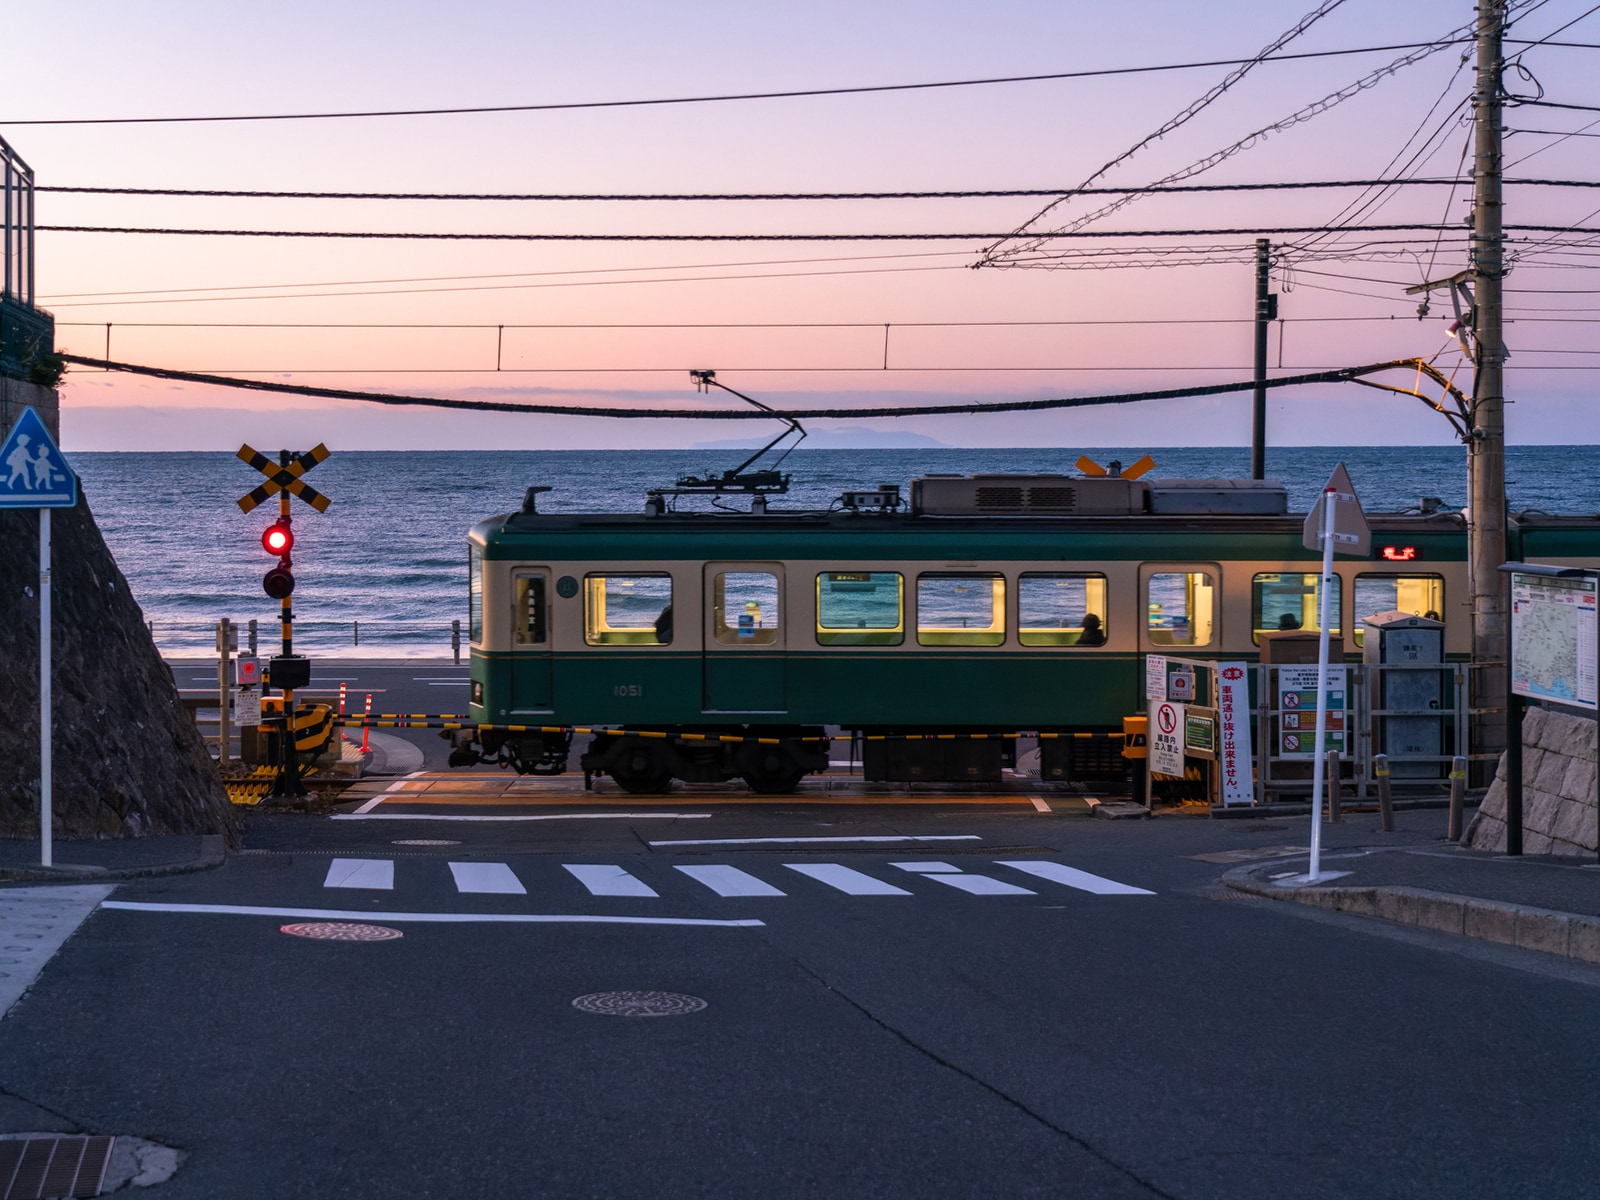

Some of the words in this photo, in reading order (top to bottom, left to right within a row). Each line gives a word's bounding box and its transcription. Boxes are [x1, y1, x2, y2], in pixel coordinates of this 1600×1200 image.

[613, 685, 642, 697] 1051
[1157, 733, 1176, 745] 線路内
[1221, 685, 1238, 789] 車両通り抜け出来ません。
[1154, 742, 1180, 754] 立入禁止
